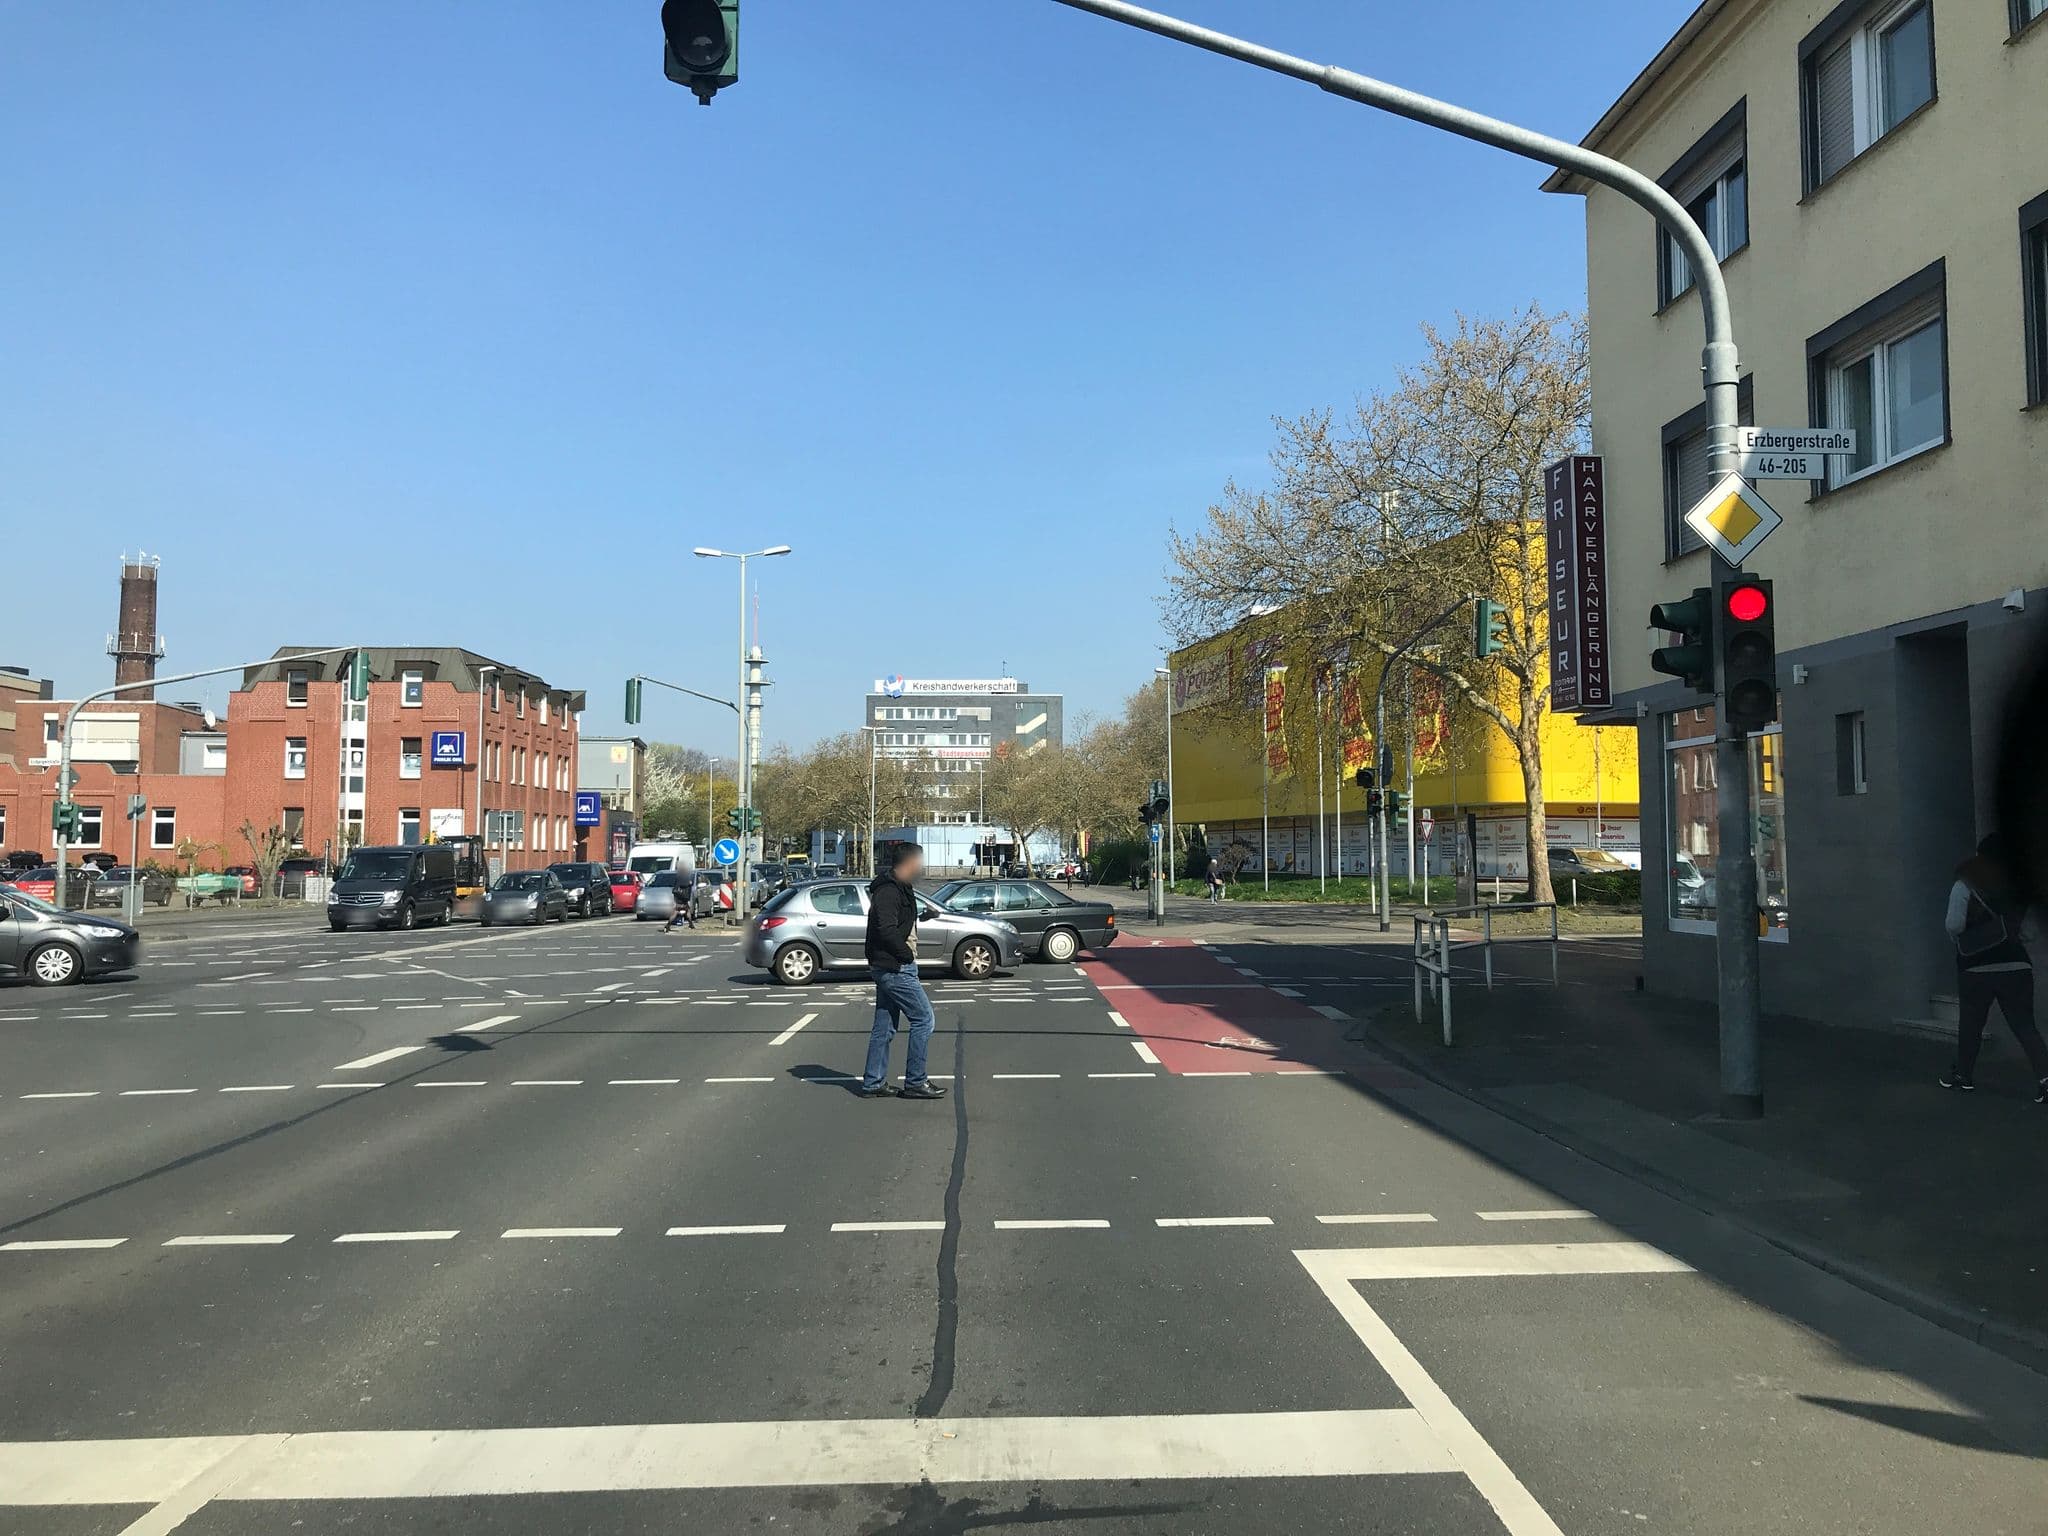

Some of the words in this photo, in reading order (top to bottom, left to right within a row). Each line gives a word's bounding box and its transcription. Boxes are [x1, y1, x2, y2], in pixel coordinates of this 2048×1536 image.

[1747, 432, 1850, 451] Erzbergerstraße
[1759, 458, 1806, 474] 46-205
[1552, 467, 1569, 673] FRISEUR
[1583, 462, 1602, 698] HAARVERLÄNGERUNG
[912, 682, 1016, 691] Kreishandwerkerschaft
